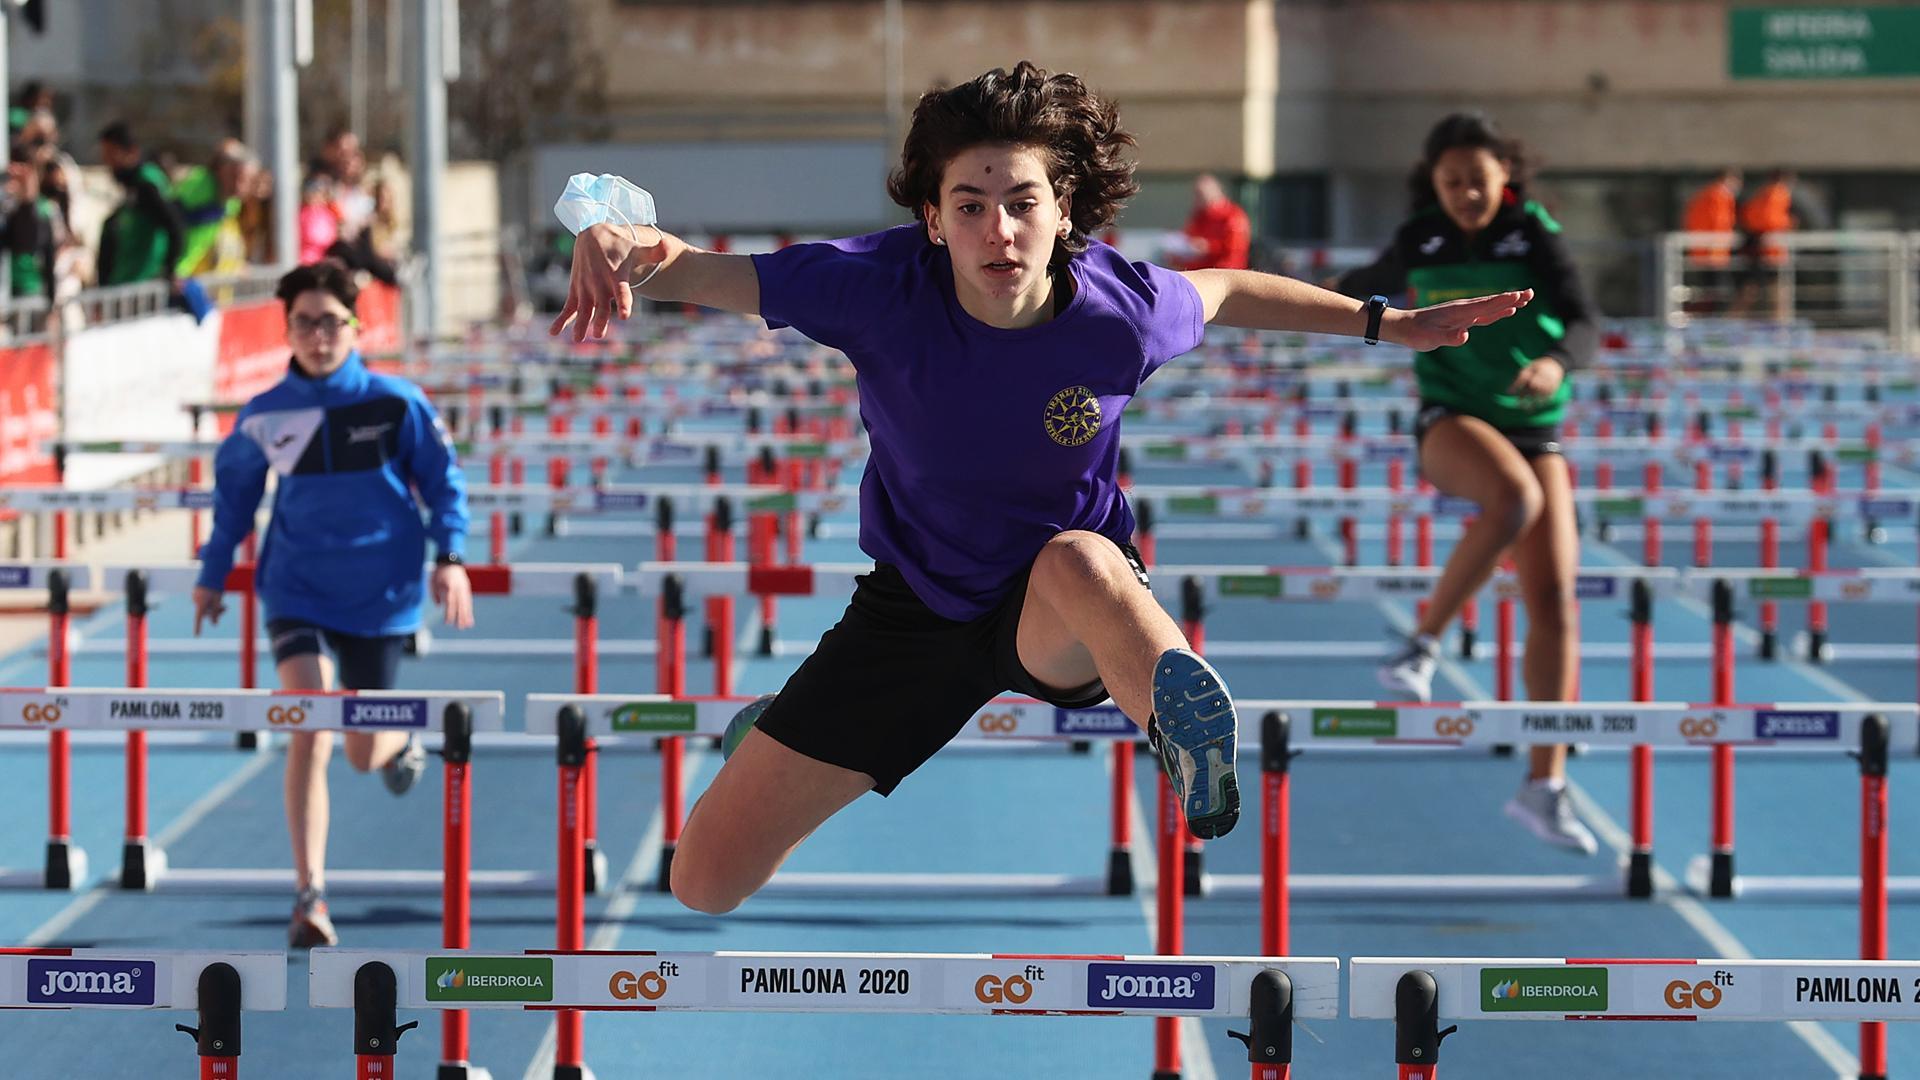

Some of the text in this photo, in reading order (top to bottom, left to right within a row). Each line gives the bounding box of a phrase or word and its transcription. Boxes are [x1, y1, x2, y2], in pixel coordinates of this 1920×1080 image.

[110, 701, 224, 720] PAMLONA 2020
[467, 975, 544, 988] IBERDROLA
[609, 961, 679, 1000] GO fit
[741, 968, 910, 994] PAMLONA 2020
[975, 965, 1045, 1004] GO fit
[1521, 985, 1599, 997] IBERDROLA
[1664, 970, 1735, 1009] GO fit
[1796, 977, 1902, 1003] PAMLONA
